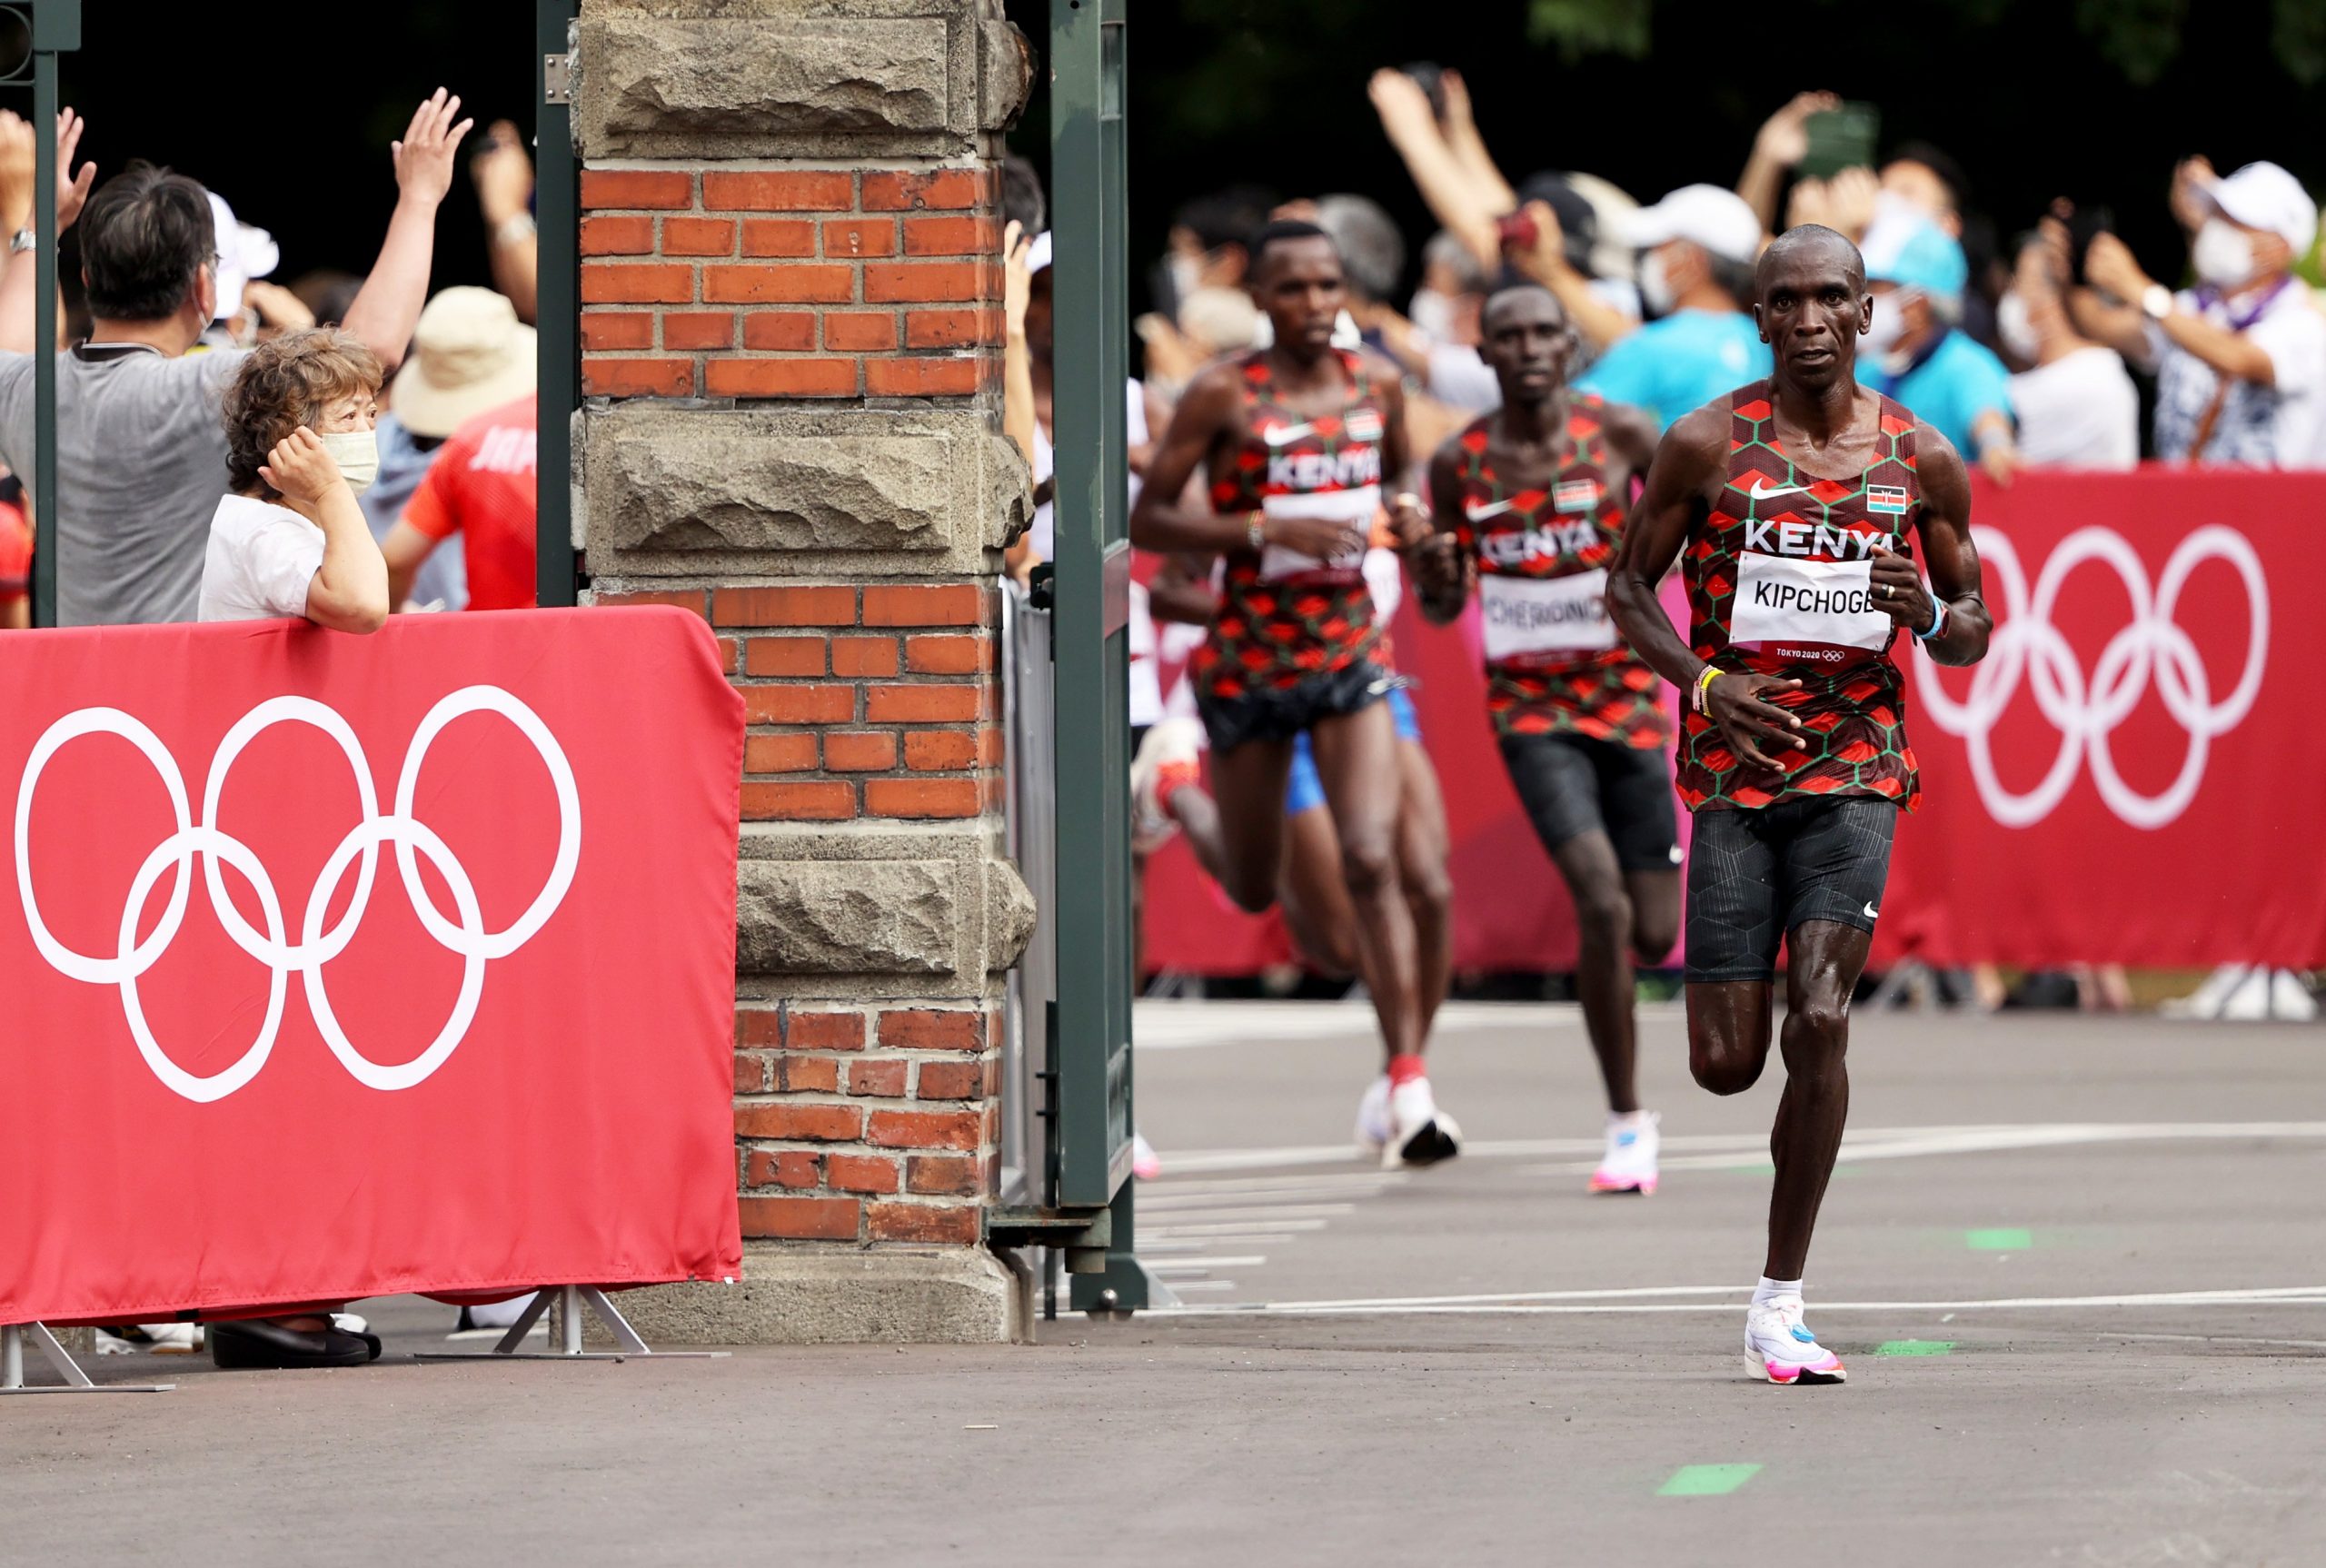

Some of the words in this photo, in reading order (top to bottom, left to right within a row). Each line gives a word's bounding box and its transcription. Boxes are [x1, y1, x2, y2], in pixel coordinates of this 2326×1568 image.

[468, 424, 537, 476] JAP
[1267, 446, 1380, 489] KENYA
[1480, 519, 1599, 565] KENYA
[1744, 519, 1894, 561] KENYA
[1754, 580, 1874, 614] KIPCHOGE
[1776, 648, 1801, 658] TOKYO
[1802, 650, 1820, 659] 2020
